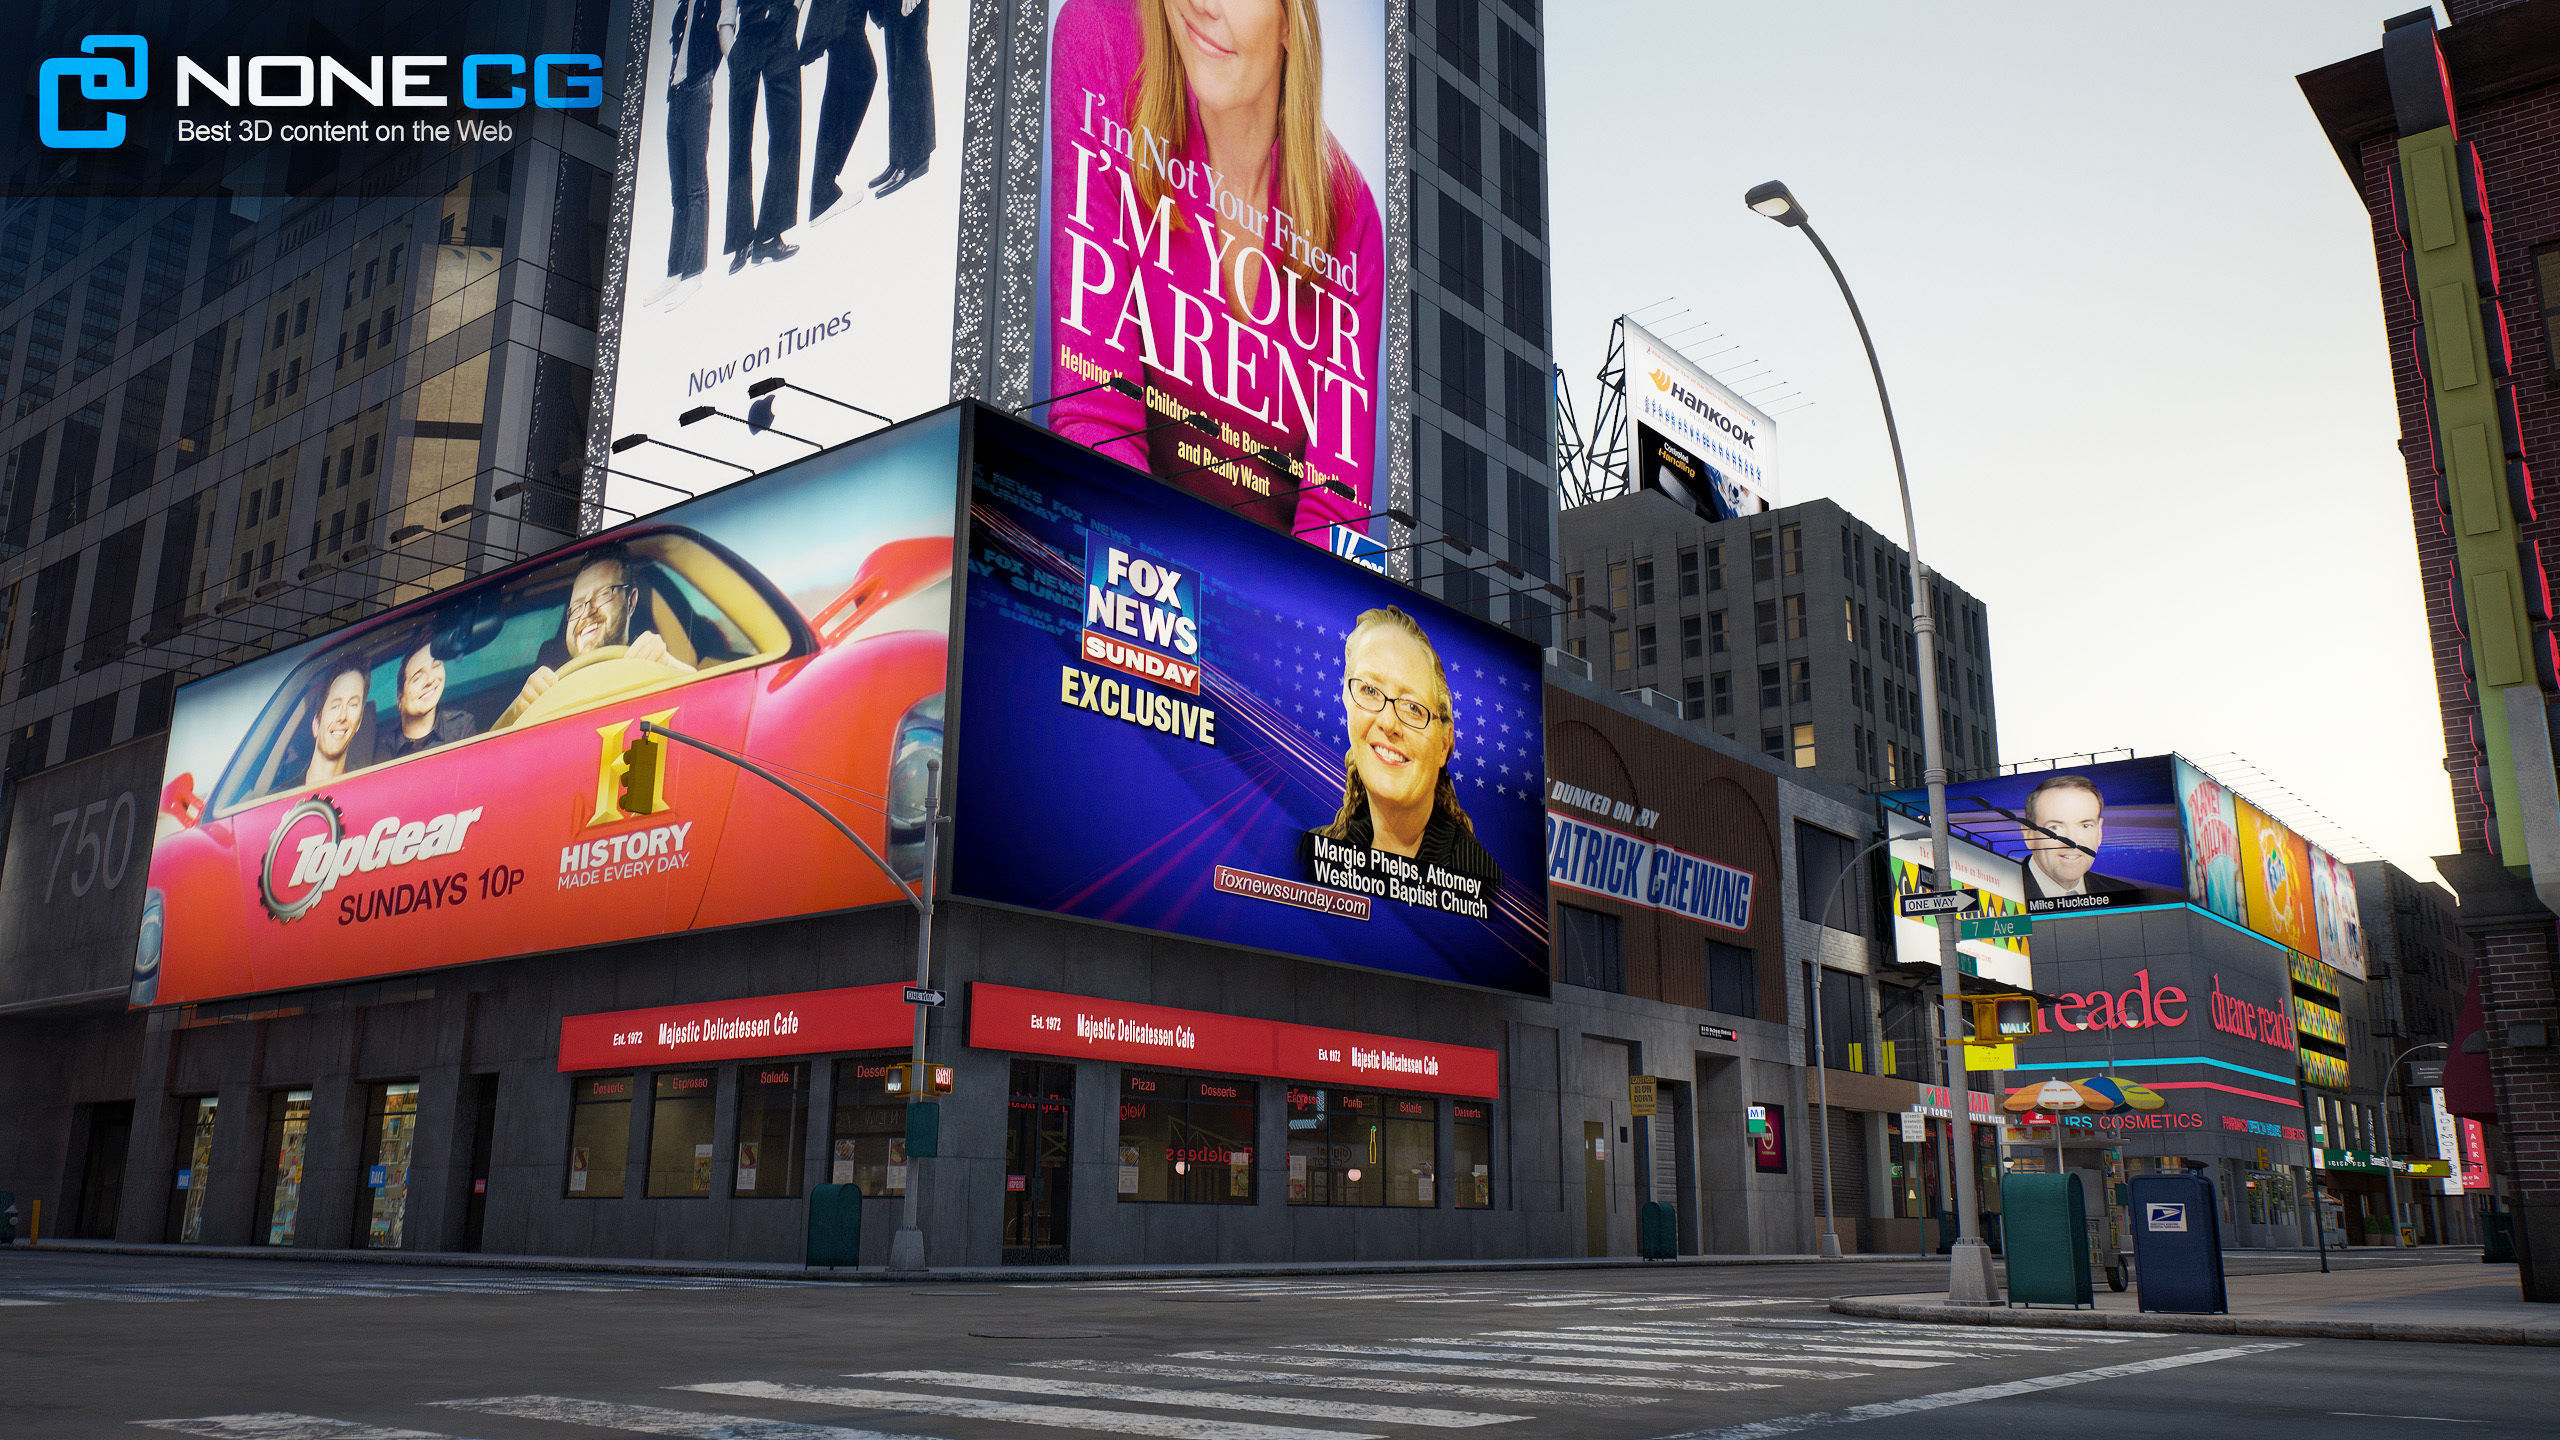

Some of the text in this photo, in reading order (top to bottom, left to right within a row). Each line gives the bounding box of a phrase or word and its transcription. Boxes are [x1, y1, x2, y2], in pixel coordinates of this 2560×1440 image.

[1139, 124, 1199, 199] Not
[1201, 162, 1269, 240] Your
[1271, 206, 1359, 296] Friend
[1067, 140, 1366, 381] I'M YOUR
[688, 311, 852, 397] Now on iTunes
[1060, 226, 1369, 468] PARENT
[1061, 344, 1112, 394] Helping
[1221, 422, 1240, 448] the
[1178, 439, 1200, 465] and
[1240, 466, 1271, 496] Want
[1107, 547, 1182, 609] FOX
[1088, 584, 1198, 656] NEWS
[1086, 636, 1197, 687] SUNDAY
[1061, 665, 1215, 745] EXCLUSIVE
[1551, 781, 1660, 830] DUNKED ON BY
[45, 791, 136, 904] 750
[559, 821, 693, 873] HISTORY
[1314, 835, 1482, 898] Margie Phelps, Attorney
[338, 872, 468, 926] SUNDAYS
[557, 869, 600, 891] MADE
[603, 858, 654, 882] EVERY
[1220, 869, 1366, 915] foxnewssunday.com
[1314, 860, 1488, 919] Westboro Baptist Church
[1647, 848, 1751, 927] CHEWING
[1908, 896, 1956, 911] ONE WAY
[1972, 920, 2014, 937] 7 Ave
[2029, 895, 2110, 911] Mike Huckabee
[659, 1019, 701, 1050] Majestic
[703, 1016, 770, 1042] Delicatessen
[773, 1010, 799, 1036] Cafe
[1046, 1016, 1061, 1031] 1972
[1077, 1013, 1116, 1044] Majestic
[1118, 1018, 1174, 1047] Delicatessen
[1176, 1025, 1195, 1049] Cafe
[2000, 1021, 2031, 1034] WALK
[2211, 973, 2295, 1052] duane reade
[760, 1070, 789, 1085] Salads
[1132, 1077, 1156, 1092] Pizza
[1351, 1046, 1380, 1073] Majestic
[1381, 1049, 1423, 1074] Delicatessen
[1423, 1056, 1439, 1076] Cafe
[1201, 1083, 1237, 1099] Desserts
[2099, 1113, 2203, 1129] COSMETICS
